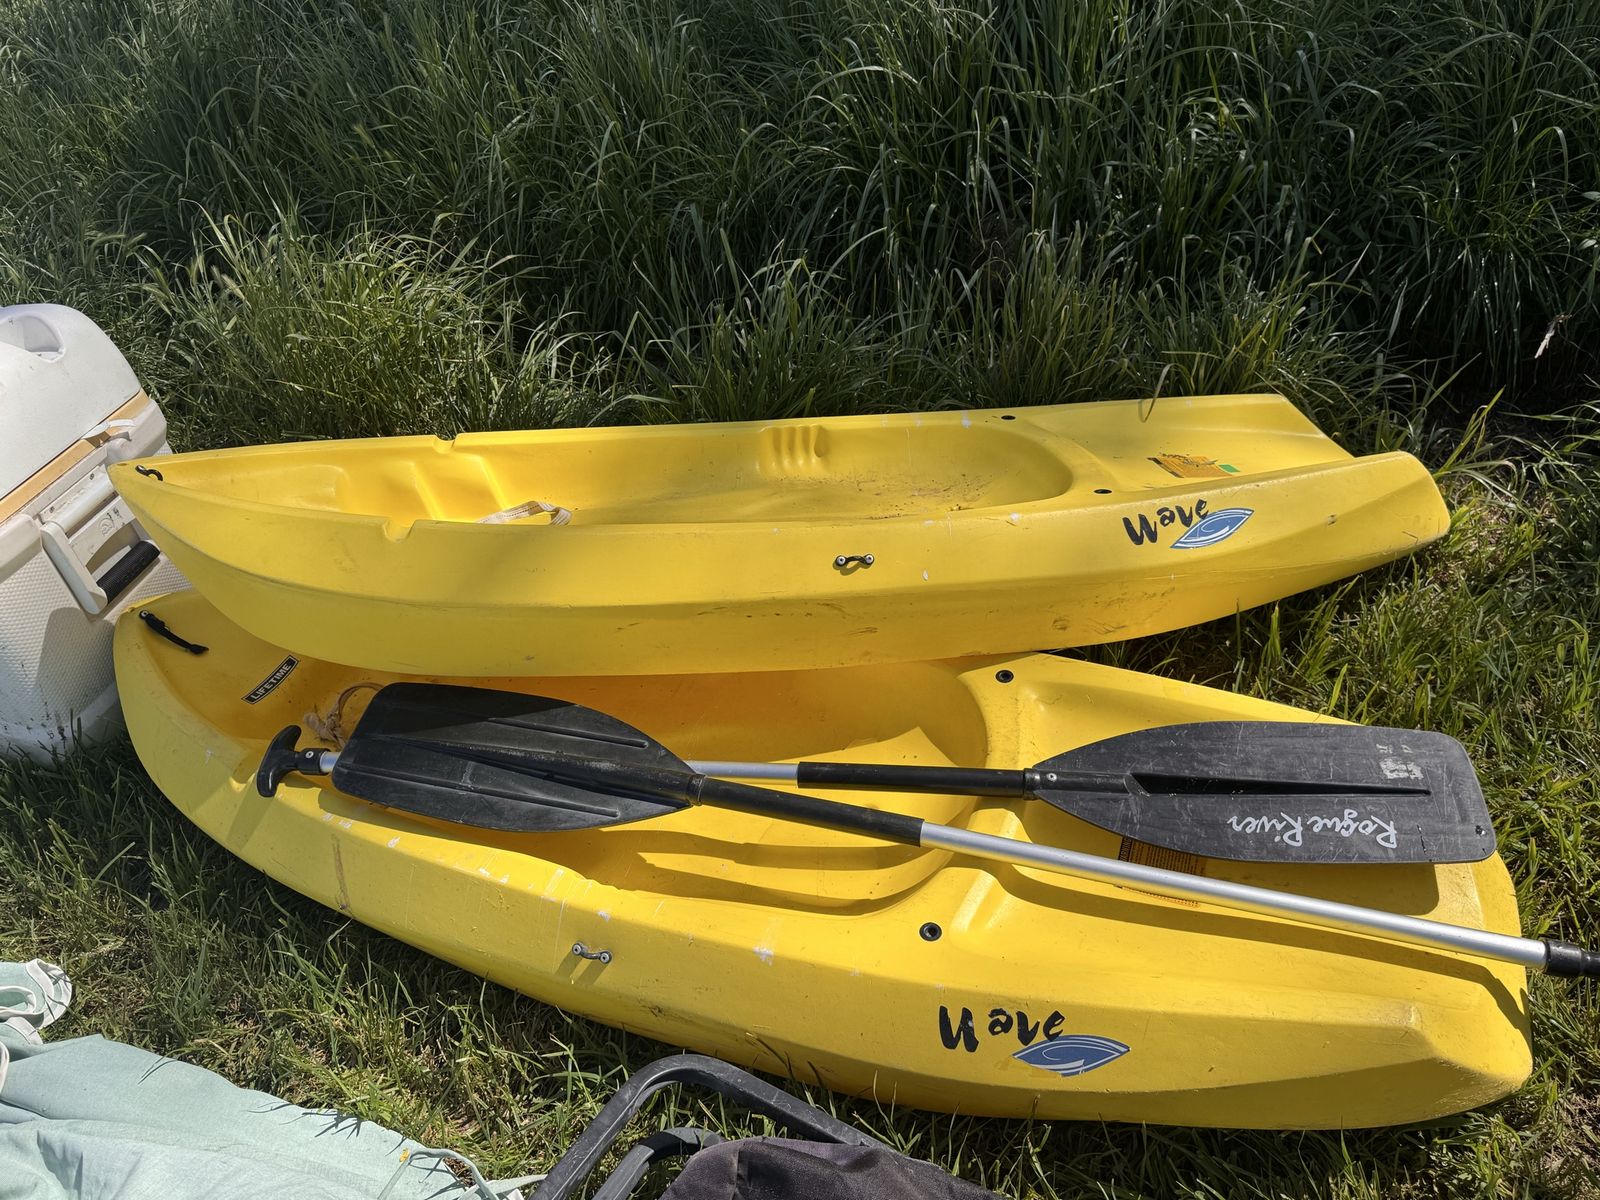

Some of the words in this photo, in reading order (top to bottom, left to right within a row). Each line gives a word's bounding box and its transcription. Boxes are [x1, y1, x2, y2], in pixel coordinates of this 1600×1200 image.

[1122, 499, 1209, 545] Wave
[250, 663, 291, 700] LIFETIME
[1227, 811, 1303, 847] River
[1307, 809, 1398, 849] Rogue
